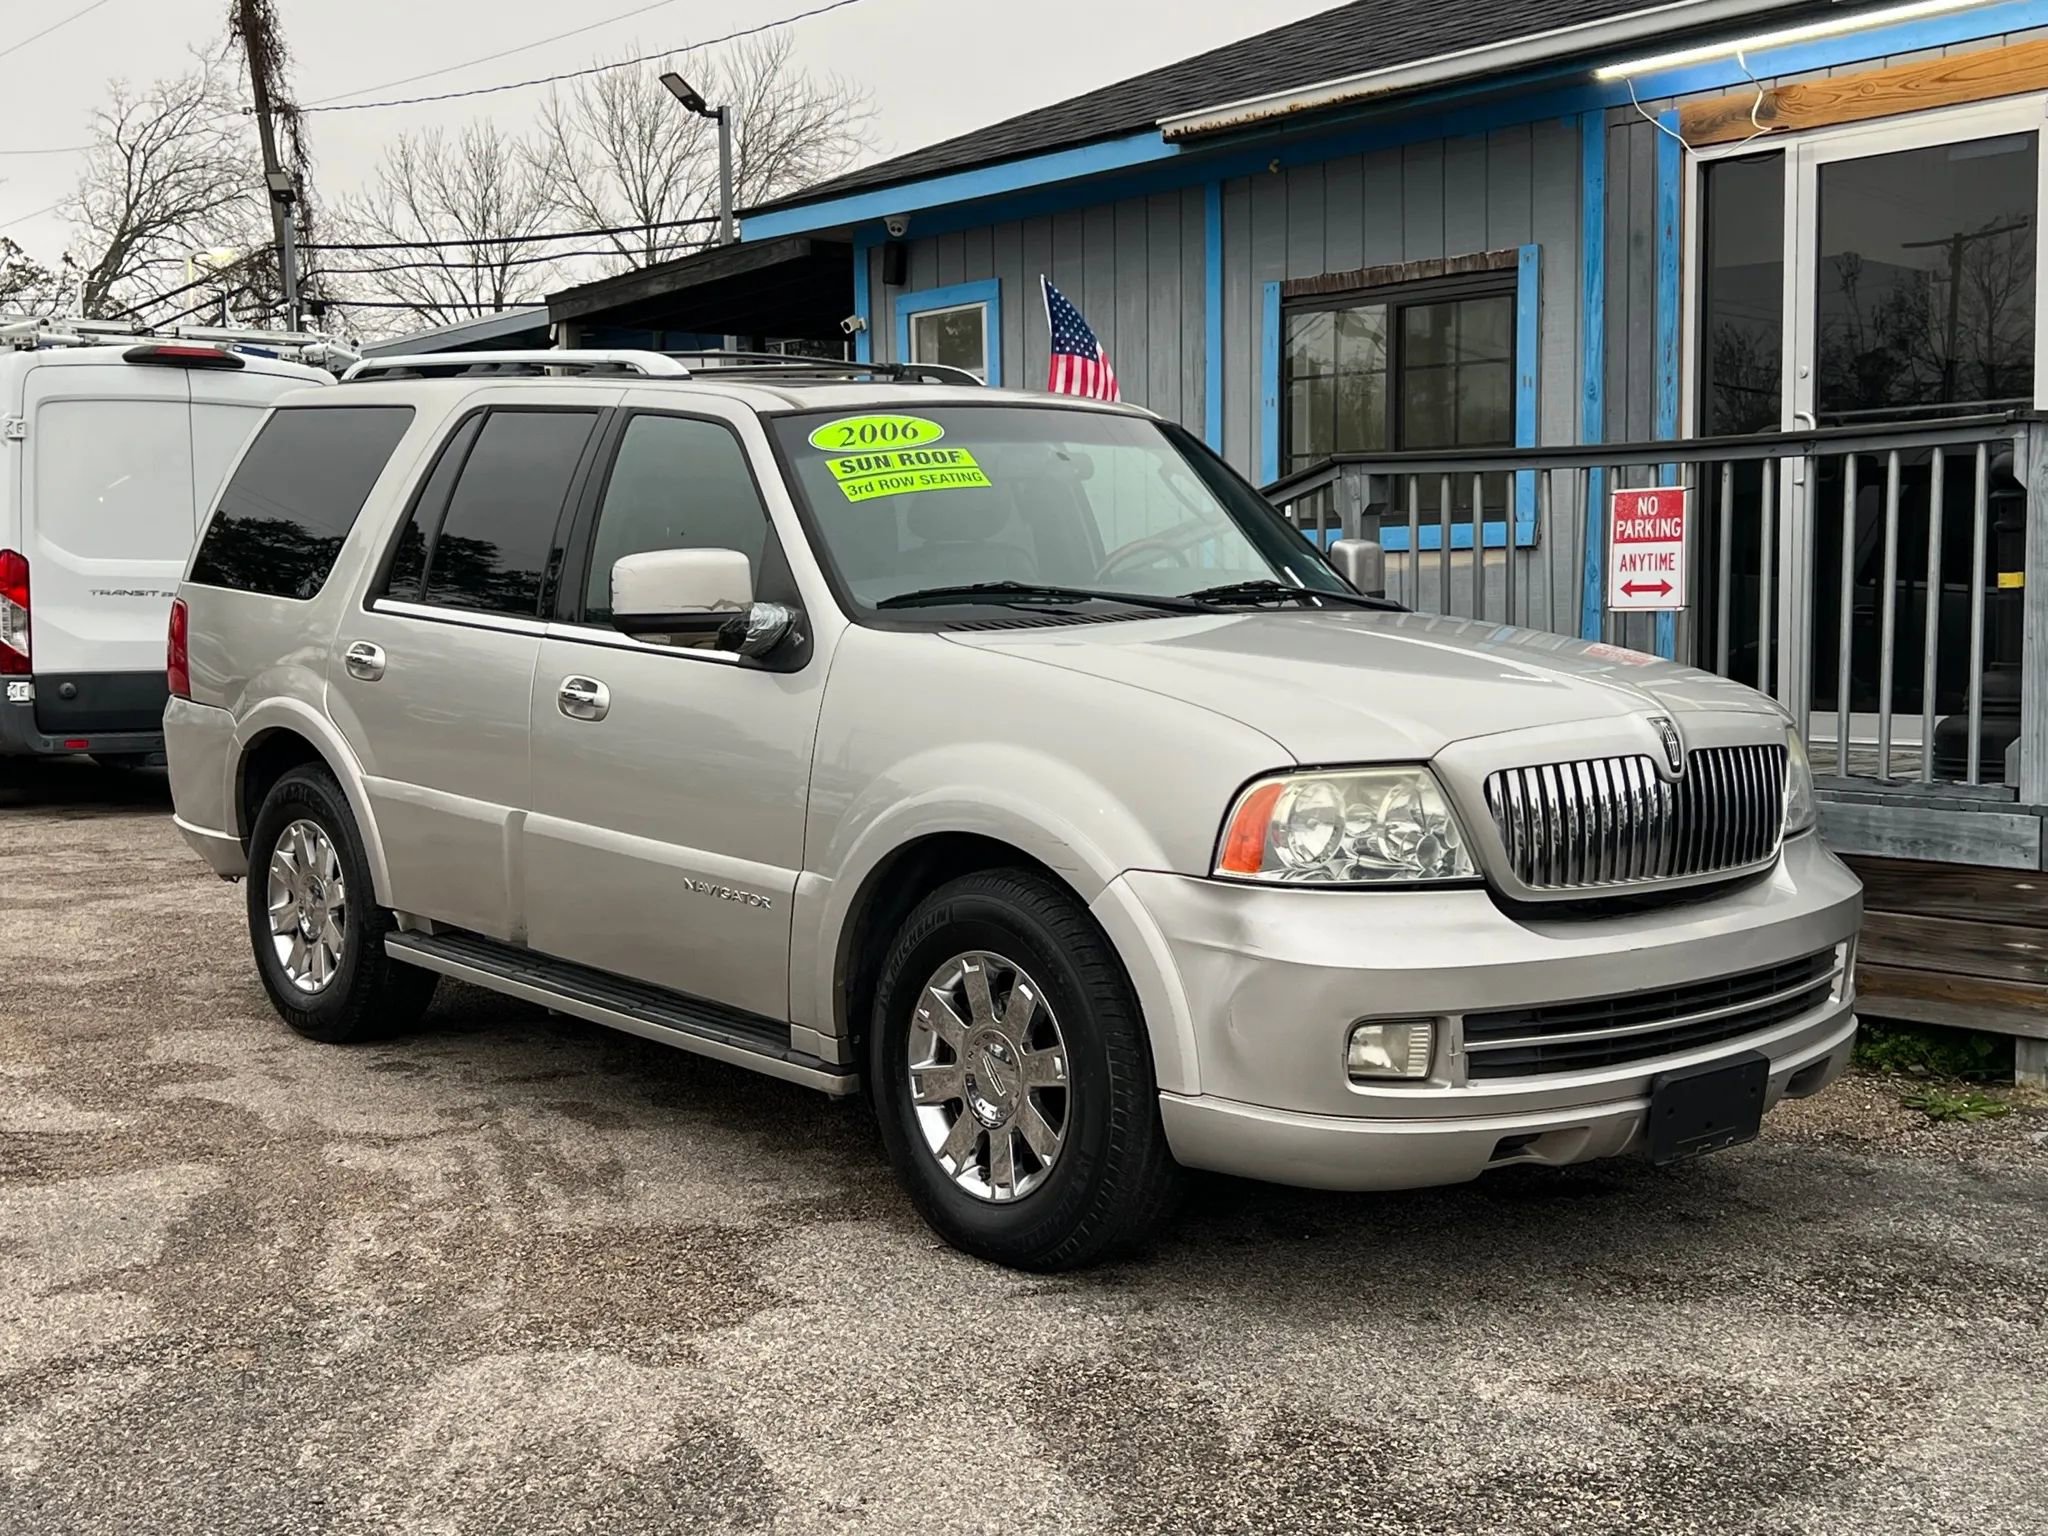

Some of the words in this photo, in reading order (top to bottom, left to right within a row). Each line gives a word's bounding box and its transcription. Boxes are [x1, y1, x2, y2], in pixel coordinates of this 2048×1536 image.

[838, 421, 919, 447] 2006
[840, 454, 891, 474] SUN
[898, 451, 961, 466] ROOF
[846, 479, 875, 498] 3rd
[879, 475, 915, 491] ROW
[919, 471, 983, 487] SEATING
[1637, 496, 1659, 516] NO
[1615, 517, 1682, 540] PARKING
[1619, 552, 1676, 573] ANYTIME
[89, 589, 160, 597] TRANSIT
[683, 877, 772, 909] NAVIGATOR
